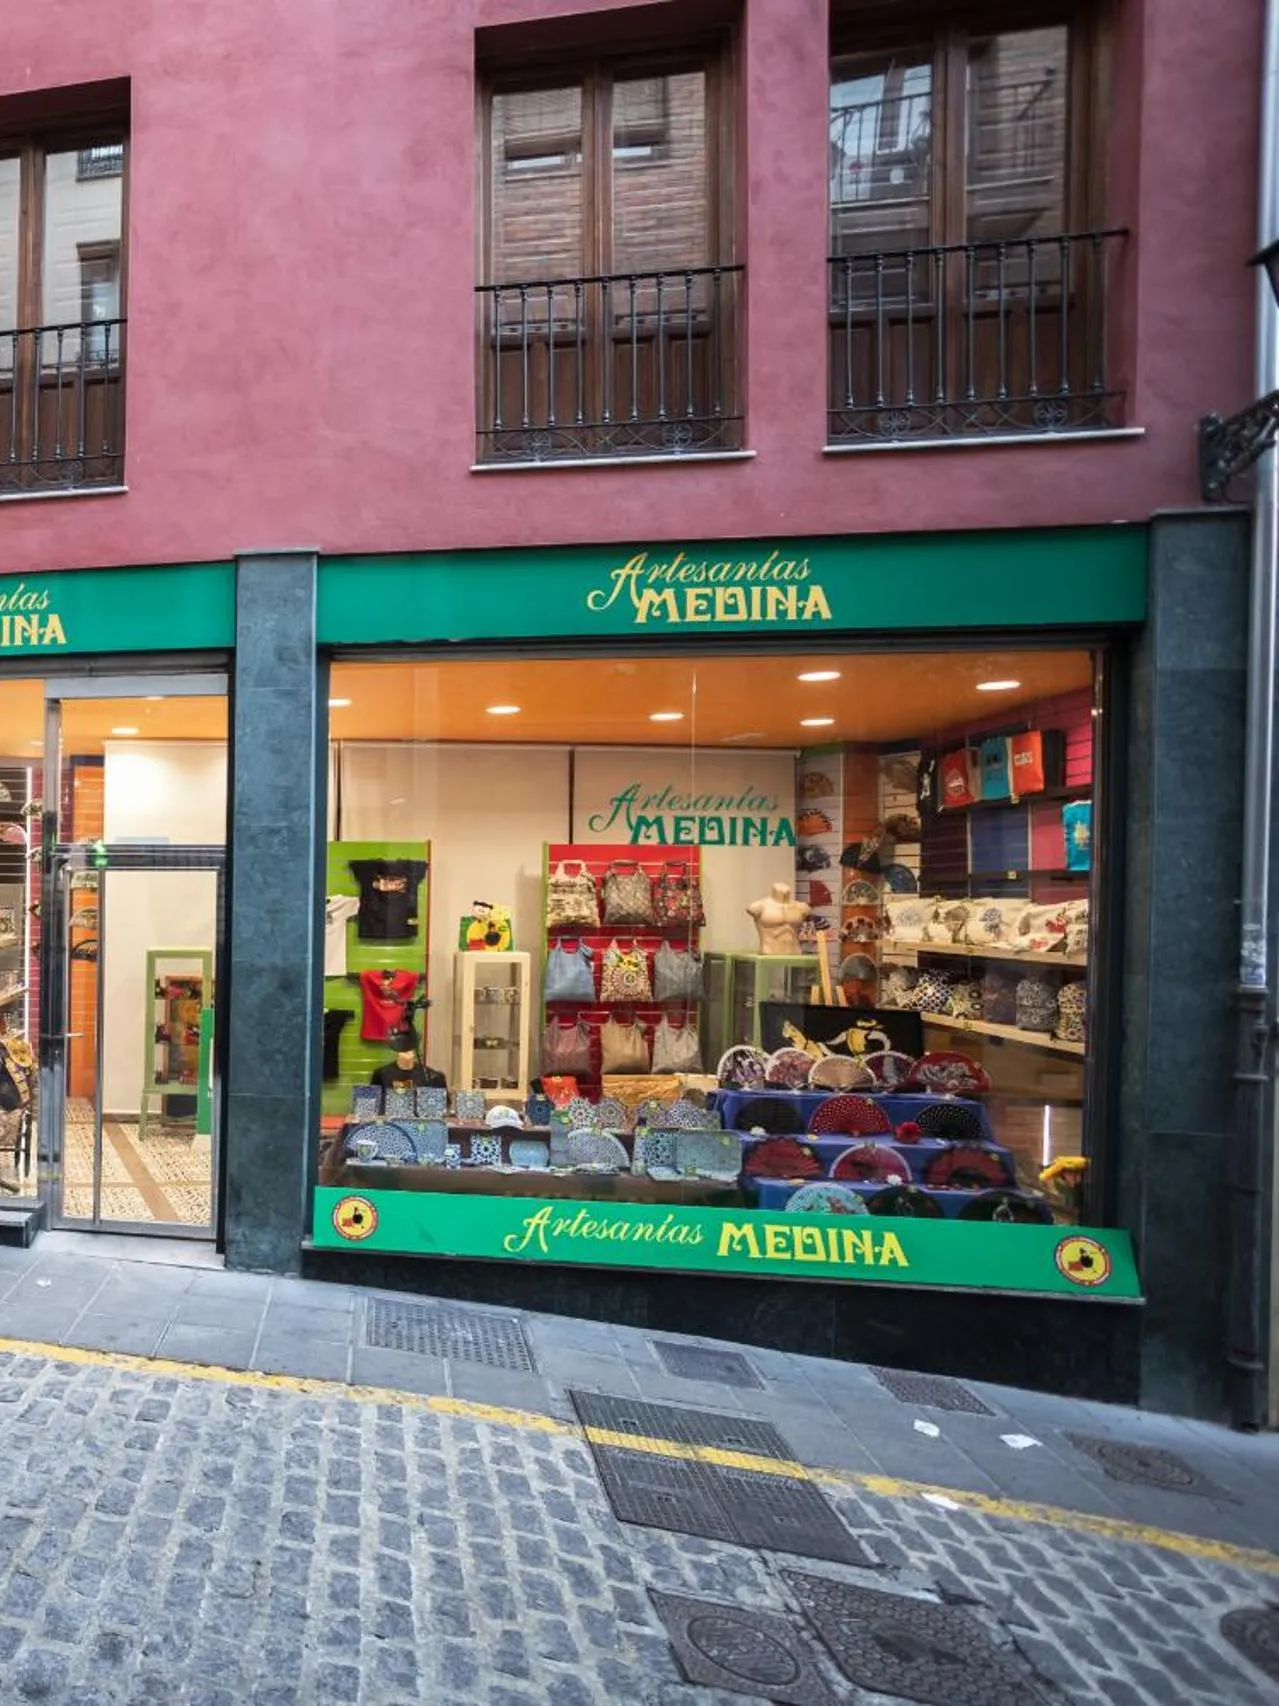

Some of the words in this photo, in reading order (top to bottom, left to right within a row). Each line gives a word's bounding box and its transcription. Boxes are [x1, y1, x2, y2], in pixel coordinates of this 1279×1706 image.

[634, 585, 833, 624] MEDINA
[628, 814, 797, 847] MEDINA
[716, 1221, 910, 1268] MEDINA
